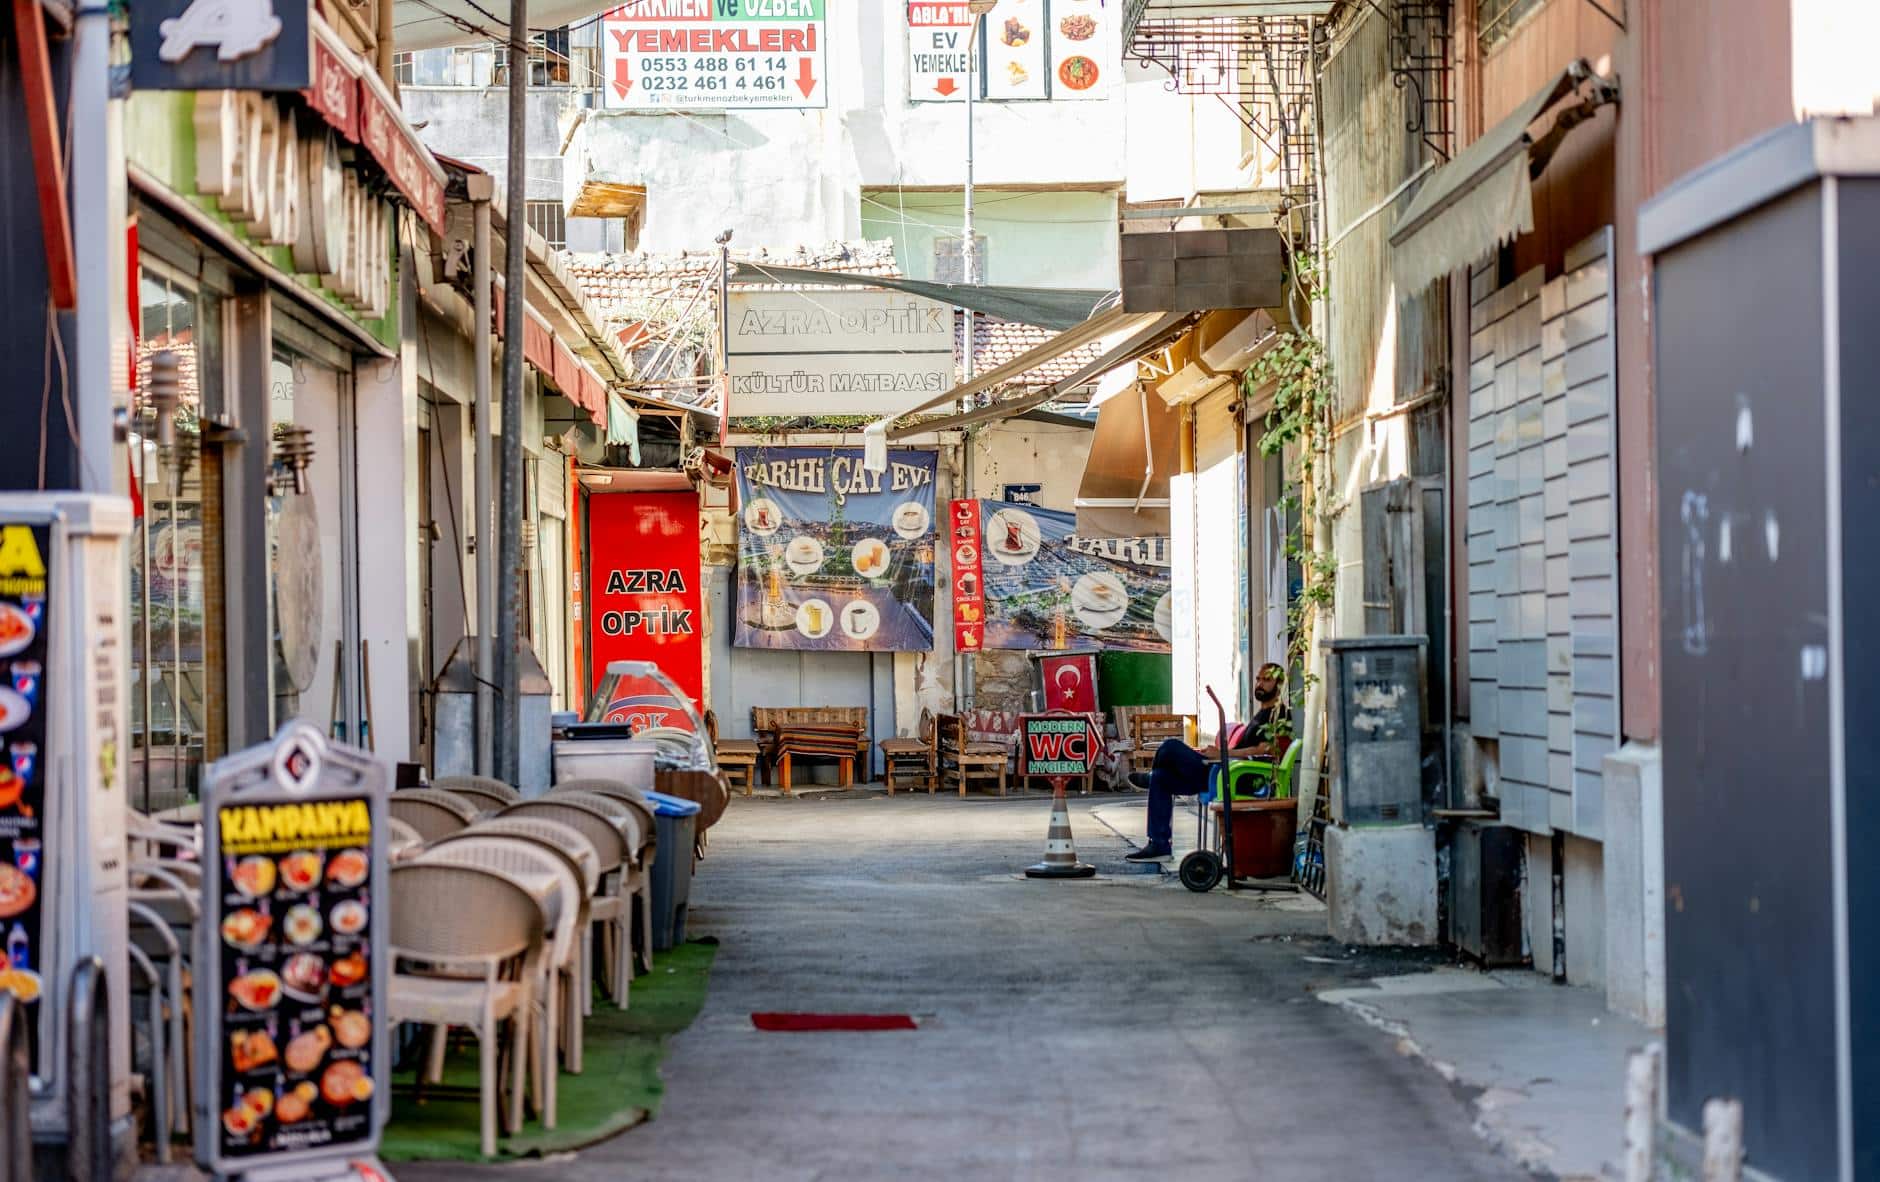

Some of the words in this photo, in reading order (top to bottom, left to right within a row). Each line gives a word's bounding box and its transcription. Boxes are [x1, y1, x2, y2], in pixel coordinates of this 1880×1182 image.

[719, 0, 738, 17] ve
[610, 24, 817, 53] YEMEKLERİ
[932, 32, 958, 49] EV
[641, 57, 688, 72] 0553
[694, 57, 729, 72] 488
[735, 57, 756, 72] 61
[765, 57, 787, 71] 14
[642, 76, 688, 90] 0232
[694, 76, 727, 90] 461
[736, 76, 747, 90] 4
[753, 76, 786, 90] 461
[738, 308, 832, 336] AZRA
[839, 303, 945, 335] OPTİK
[732, 371, 825, 394] KÜLTÜR
[829, 372, 948, 393] MATBAASI
[832, 456, 883, 506] ÇAY
[605, 568, 687, 595] AZRA
[602, 605, 693, 636] OPTİK
[1027, 720, 1086, 733] MODERN
[1028, 733, 1086, 761] WC
[1028, 761, 1086, 774] HYGIENA
[219, 799, 370, 844] KAMPANYA
